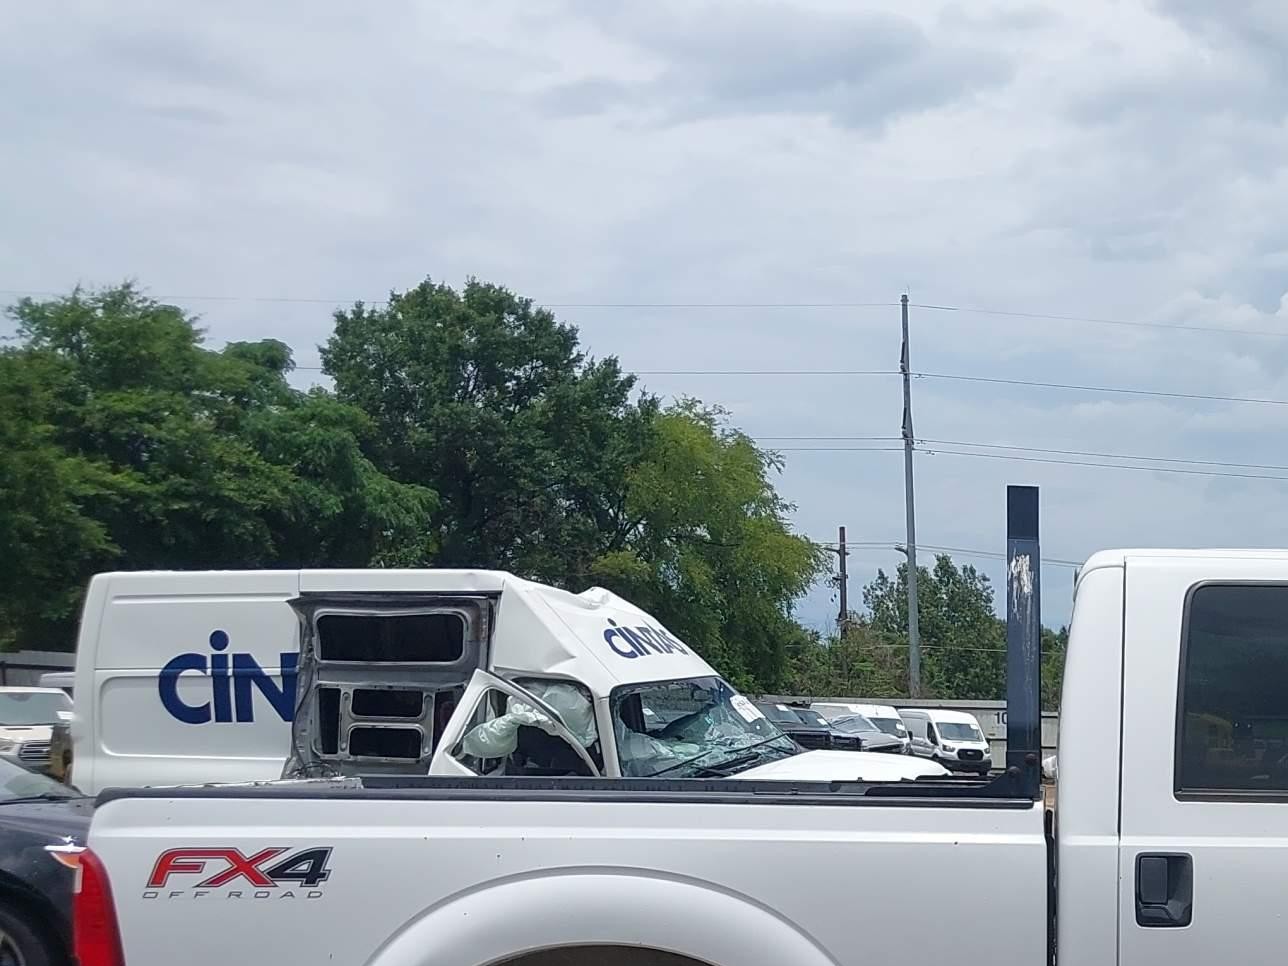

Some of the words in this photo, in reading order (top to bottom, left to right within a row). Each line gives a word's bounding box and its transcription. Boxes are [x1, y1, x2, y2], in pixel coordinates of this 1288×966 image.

[146, 847, 334, 888] FX4
[142, 891, 210, 899] OFF
[227, 891, 322, 899] ROAD
